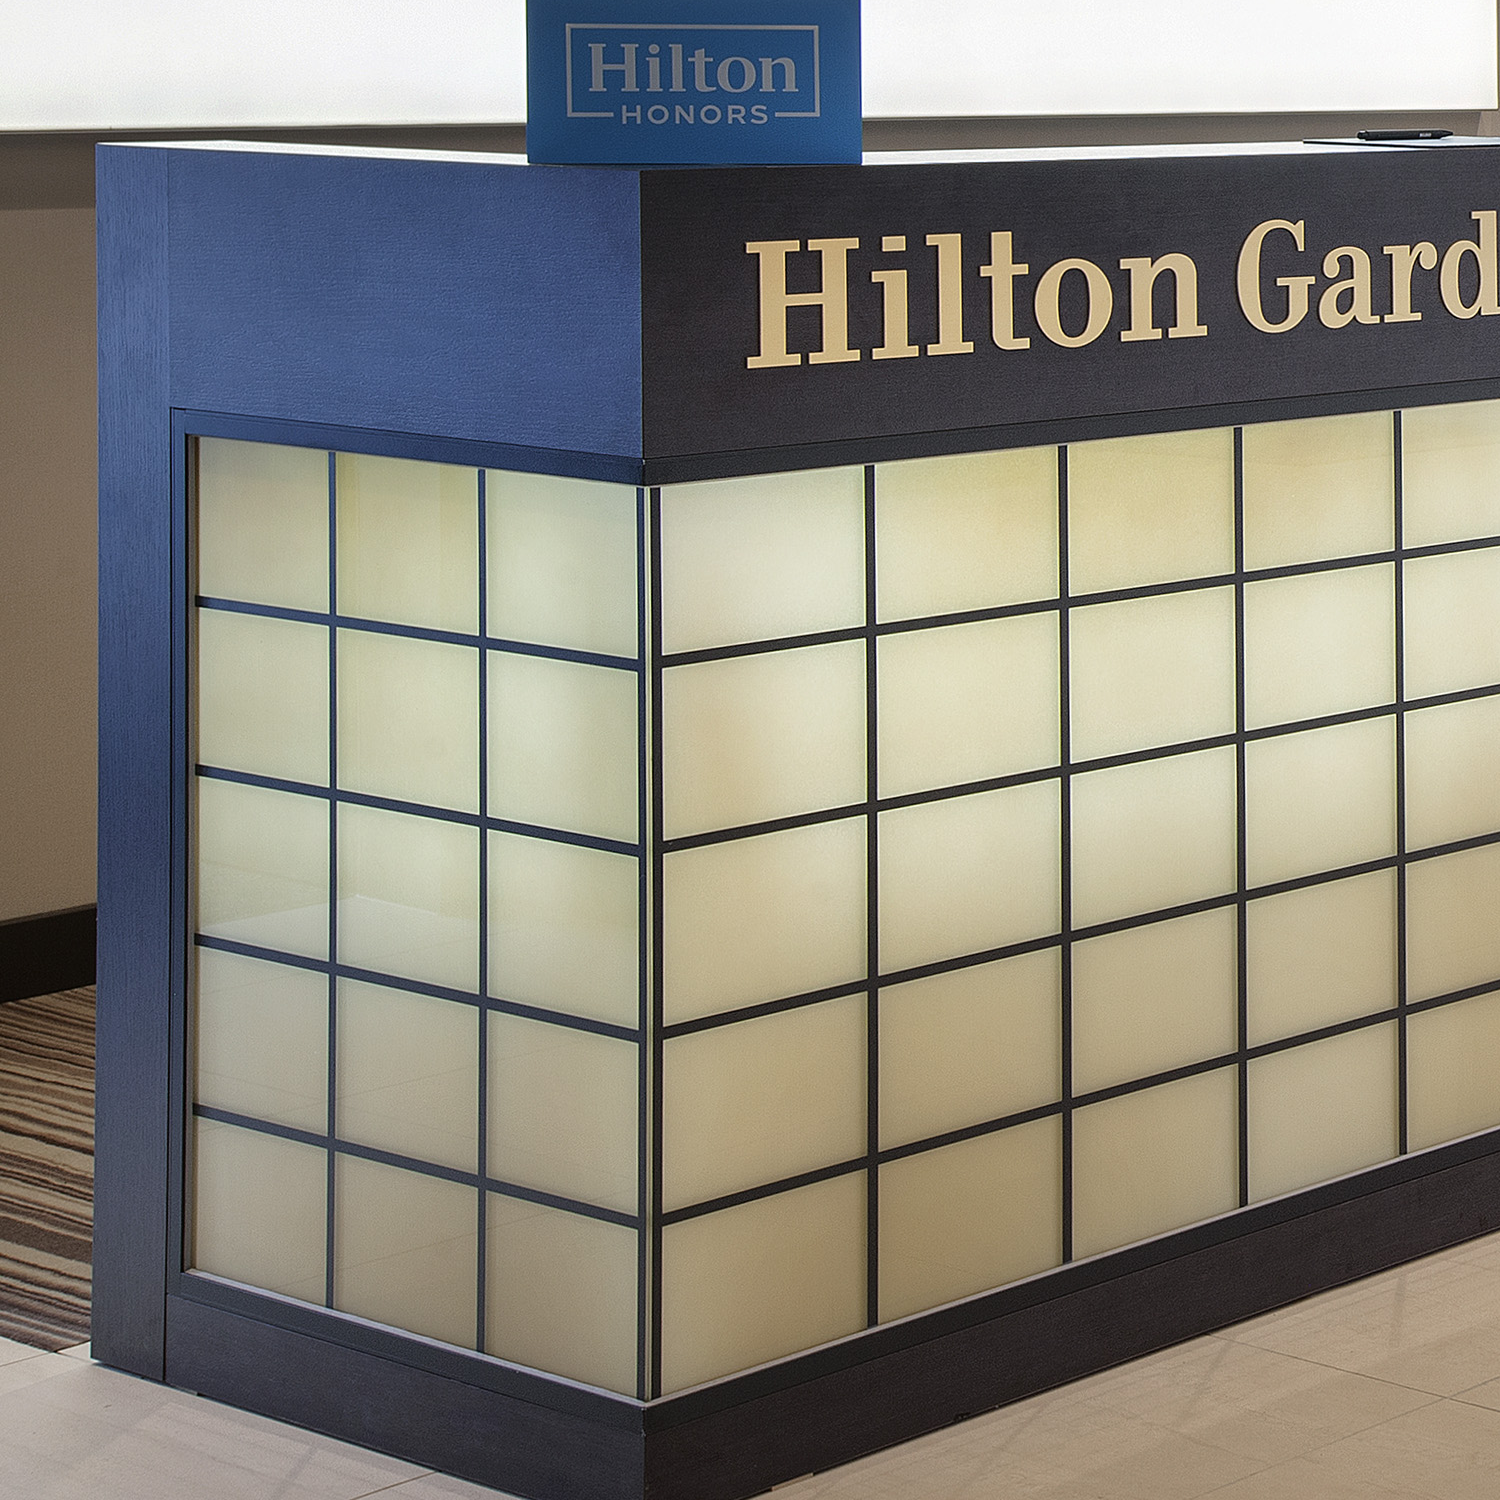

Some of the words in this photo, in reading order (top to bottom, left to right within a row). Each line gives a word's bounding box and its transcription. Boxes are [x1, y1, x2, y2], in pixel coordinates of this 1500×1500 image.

[588, 43, 799, 93] Hilton
[621, 105, 768, 125] HONORS
[745, 229, 1208, 371] Hilton
